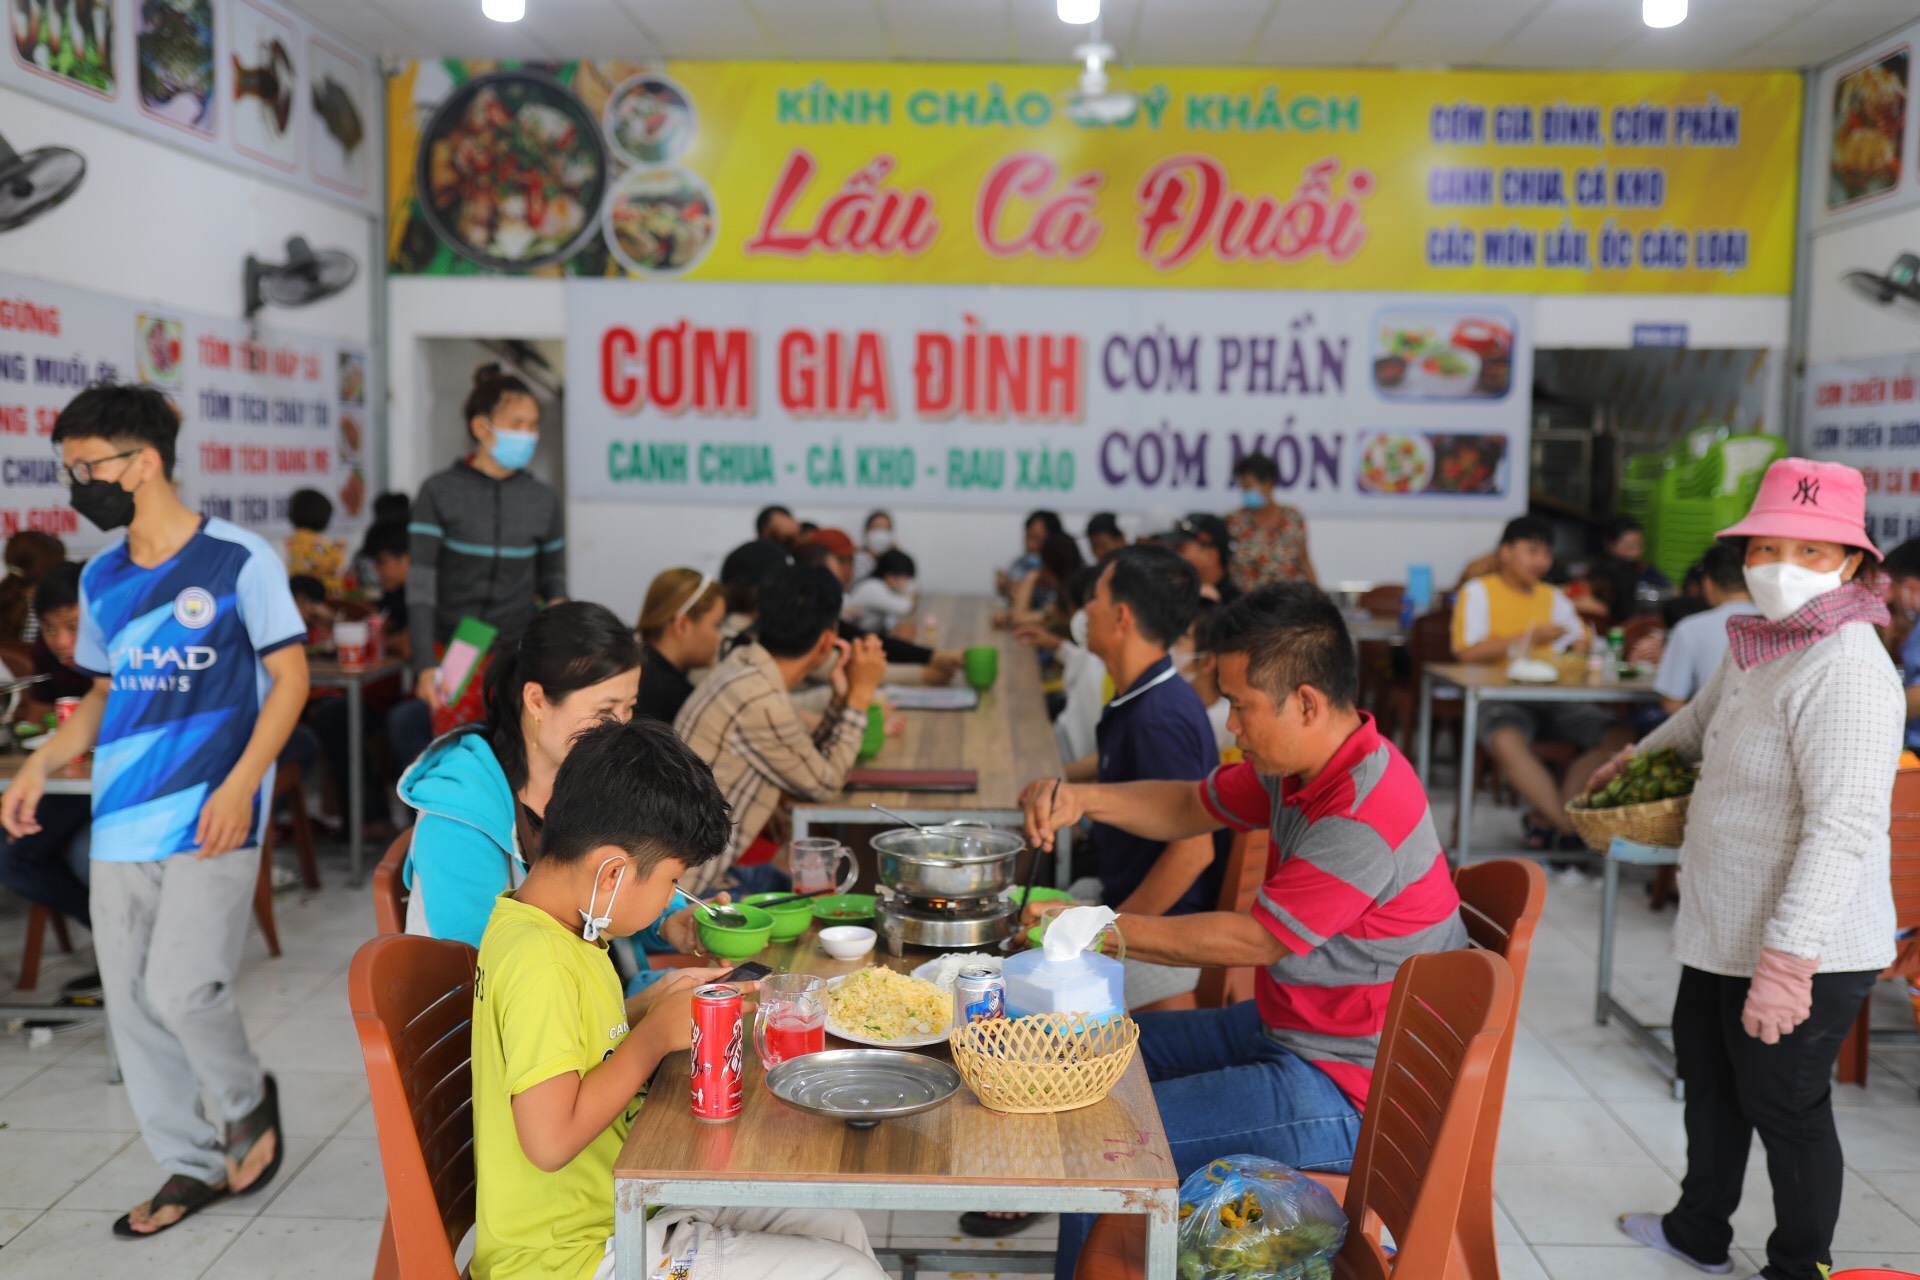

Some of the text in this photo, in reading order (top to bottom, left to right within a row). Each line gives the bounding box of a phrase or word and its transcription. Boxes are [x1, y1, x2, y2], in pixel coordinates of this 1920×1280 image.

[777, 78, 892, 126] KÍNH
[905, 80, 1054, 132] CHÀO
[1184, 85, 1361, 133] KHÁCH
[1491, 106, 1536, 145] GIA
[744, 149, 1374, 270] Lẩu Cá Đuối
[1574, 162, 1609, 207] CÁ
[1612, 169, 1665, 207] KHO
[601, 312, 1082, 420] CƠM GIA ĐÌNH
[1101, 326, 1200, 393] CƠM
[608, 440, 688, 484] CANH
[697, 442, 775, 487] CHUA
[806, 438, 846, 488] CÁ
[855, 446, 916, 490] KHO
[946, 448, 1004, 491] RAU
[1014, 440, 1075, 492] XÀO
[1099, 422, 1208, 490] CƠM
[1793, 477, 1820, 505] NY
